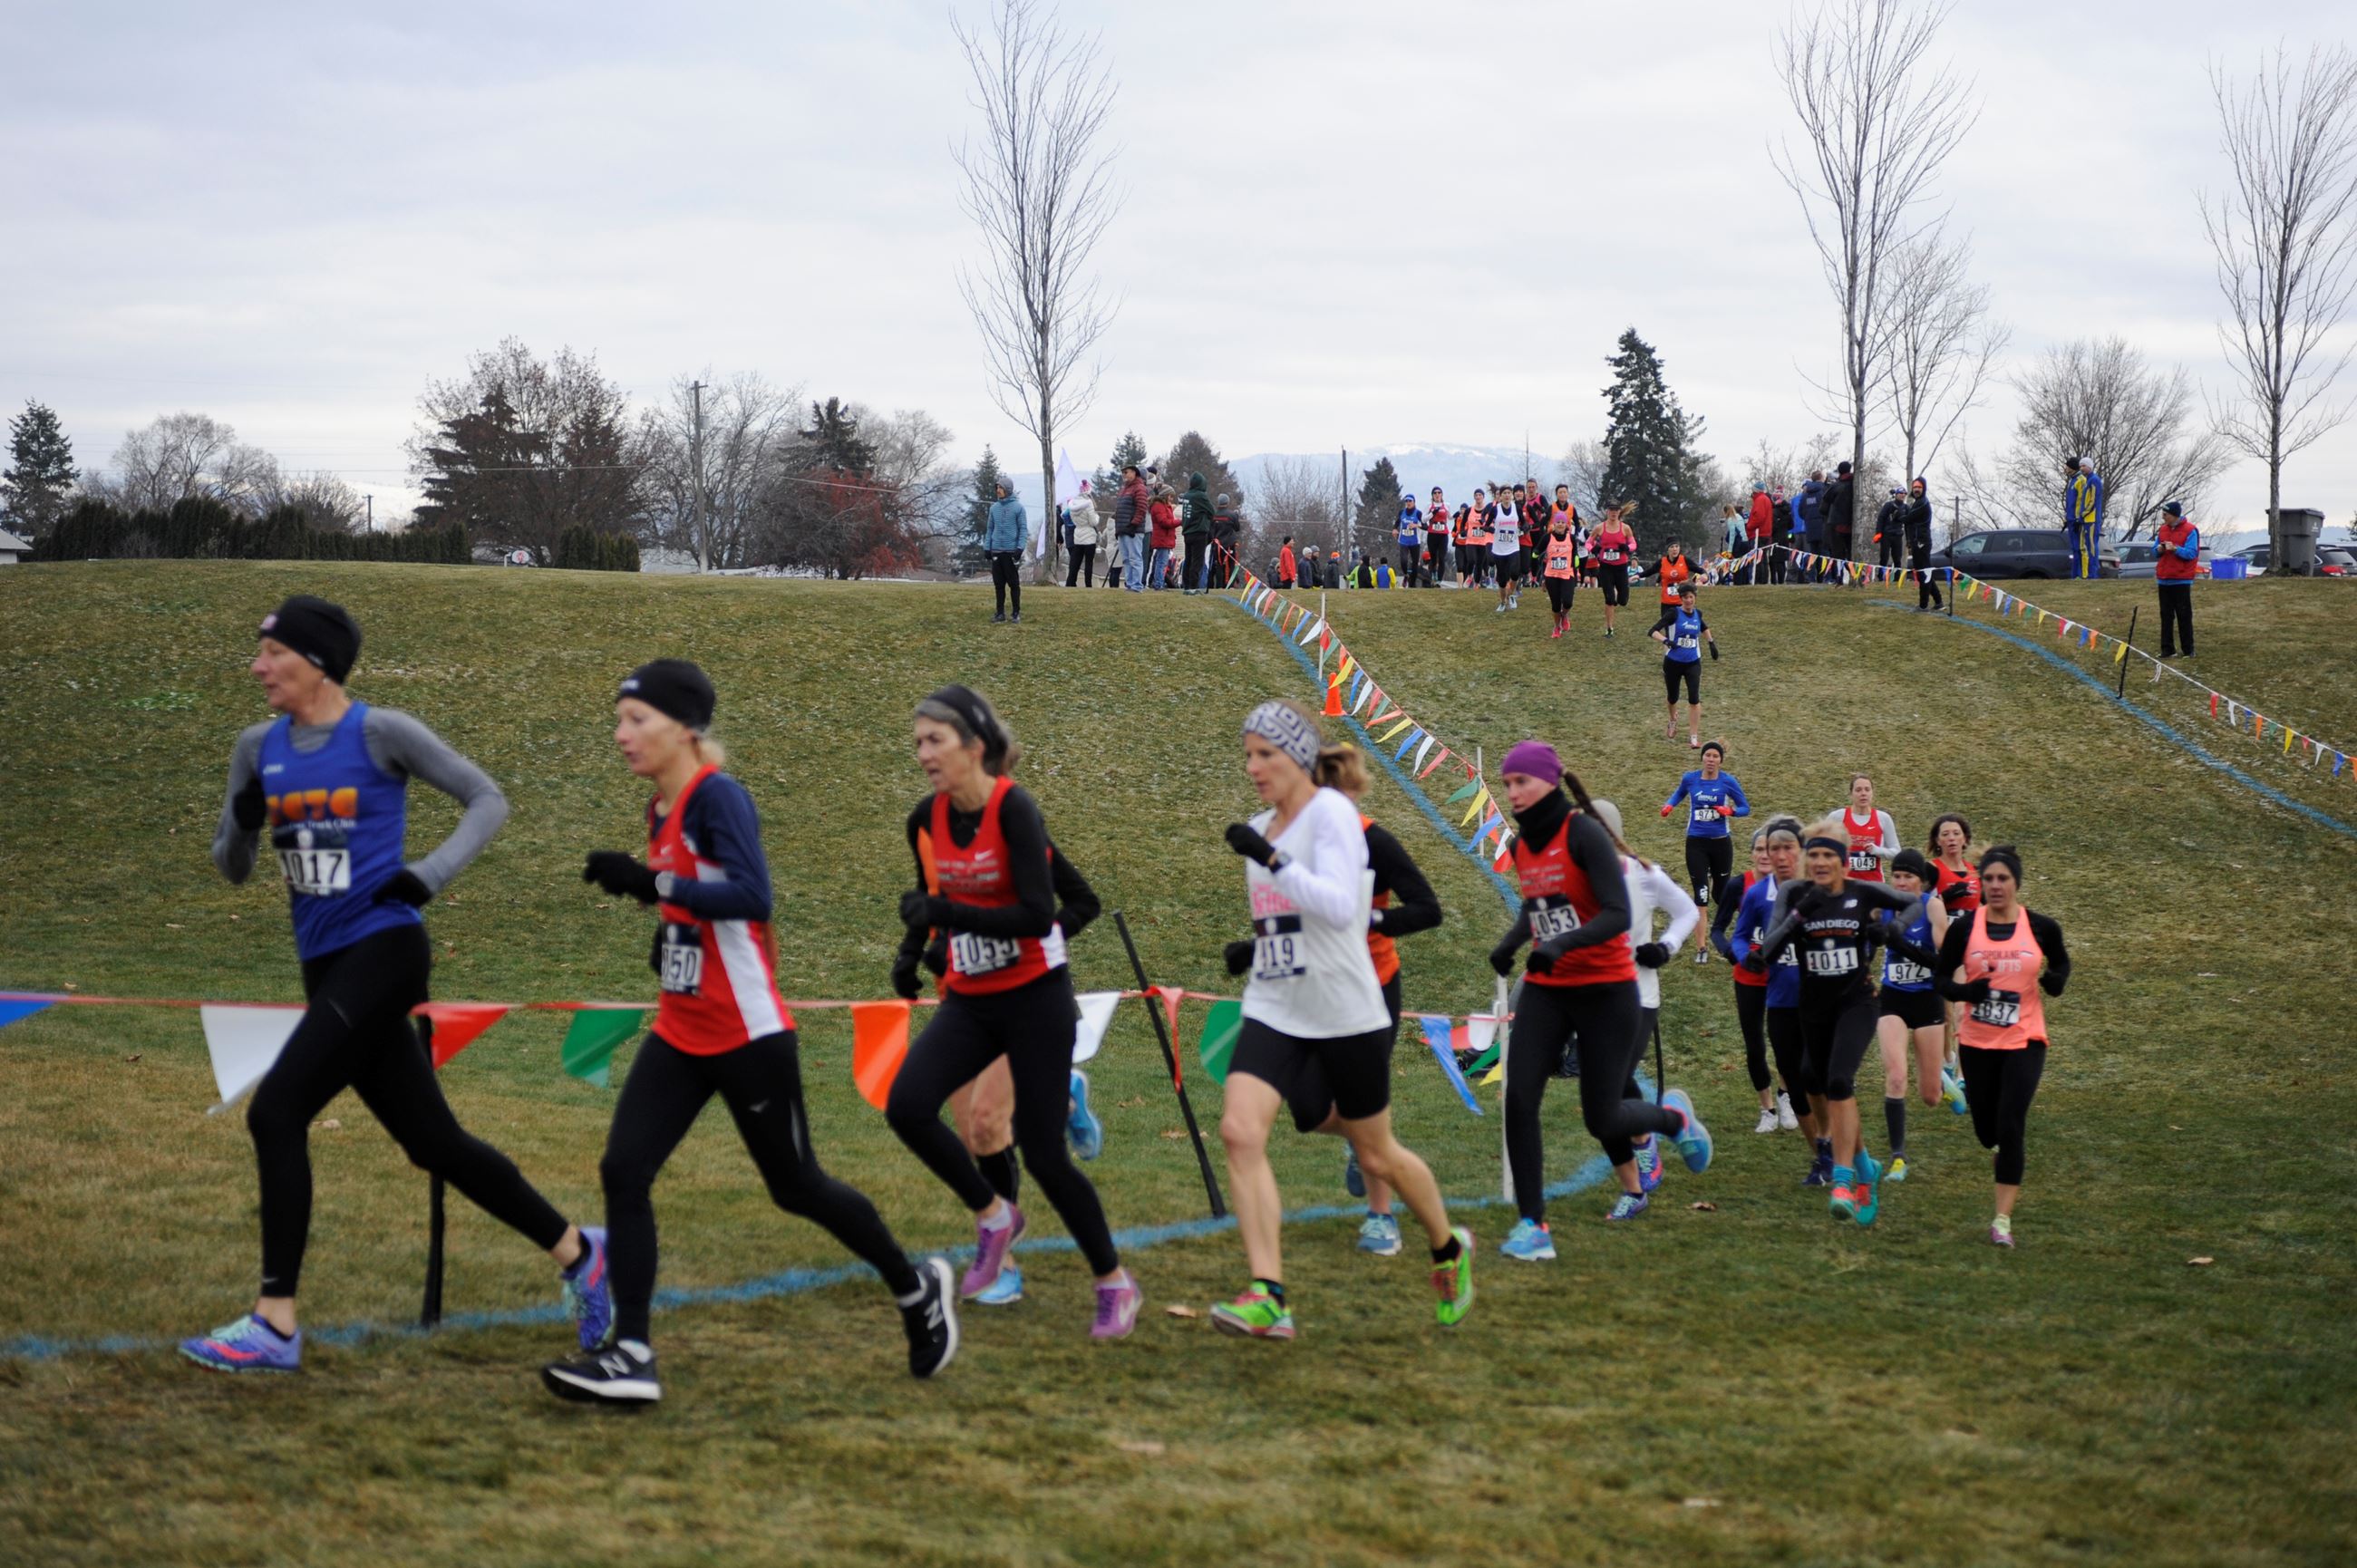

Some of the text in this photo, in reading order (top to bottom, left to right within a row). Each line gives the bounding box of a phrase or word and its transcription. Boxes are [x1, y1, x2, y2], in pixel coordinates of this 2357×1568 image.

[281, 852, 343, 885] 1017
[1850, 857, 1875, 868] 1043
[1804, 918, 1859, 932] SAN DIEGO
[1809, 950, 1855, 971] 1011
[1981, 959, 2021, 973] SIFTS
[1896, 963, 1925, 980] 972
